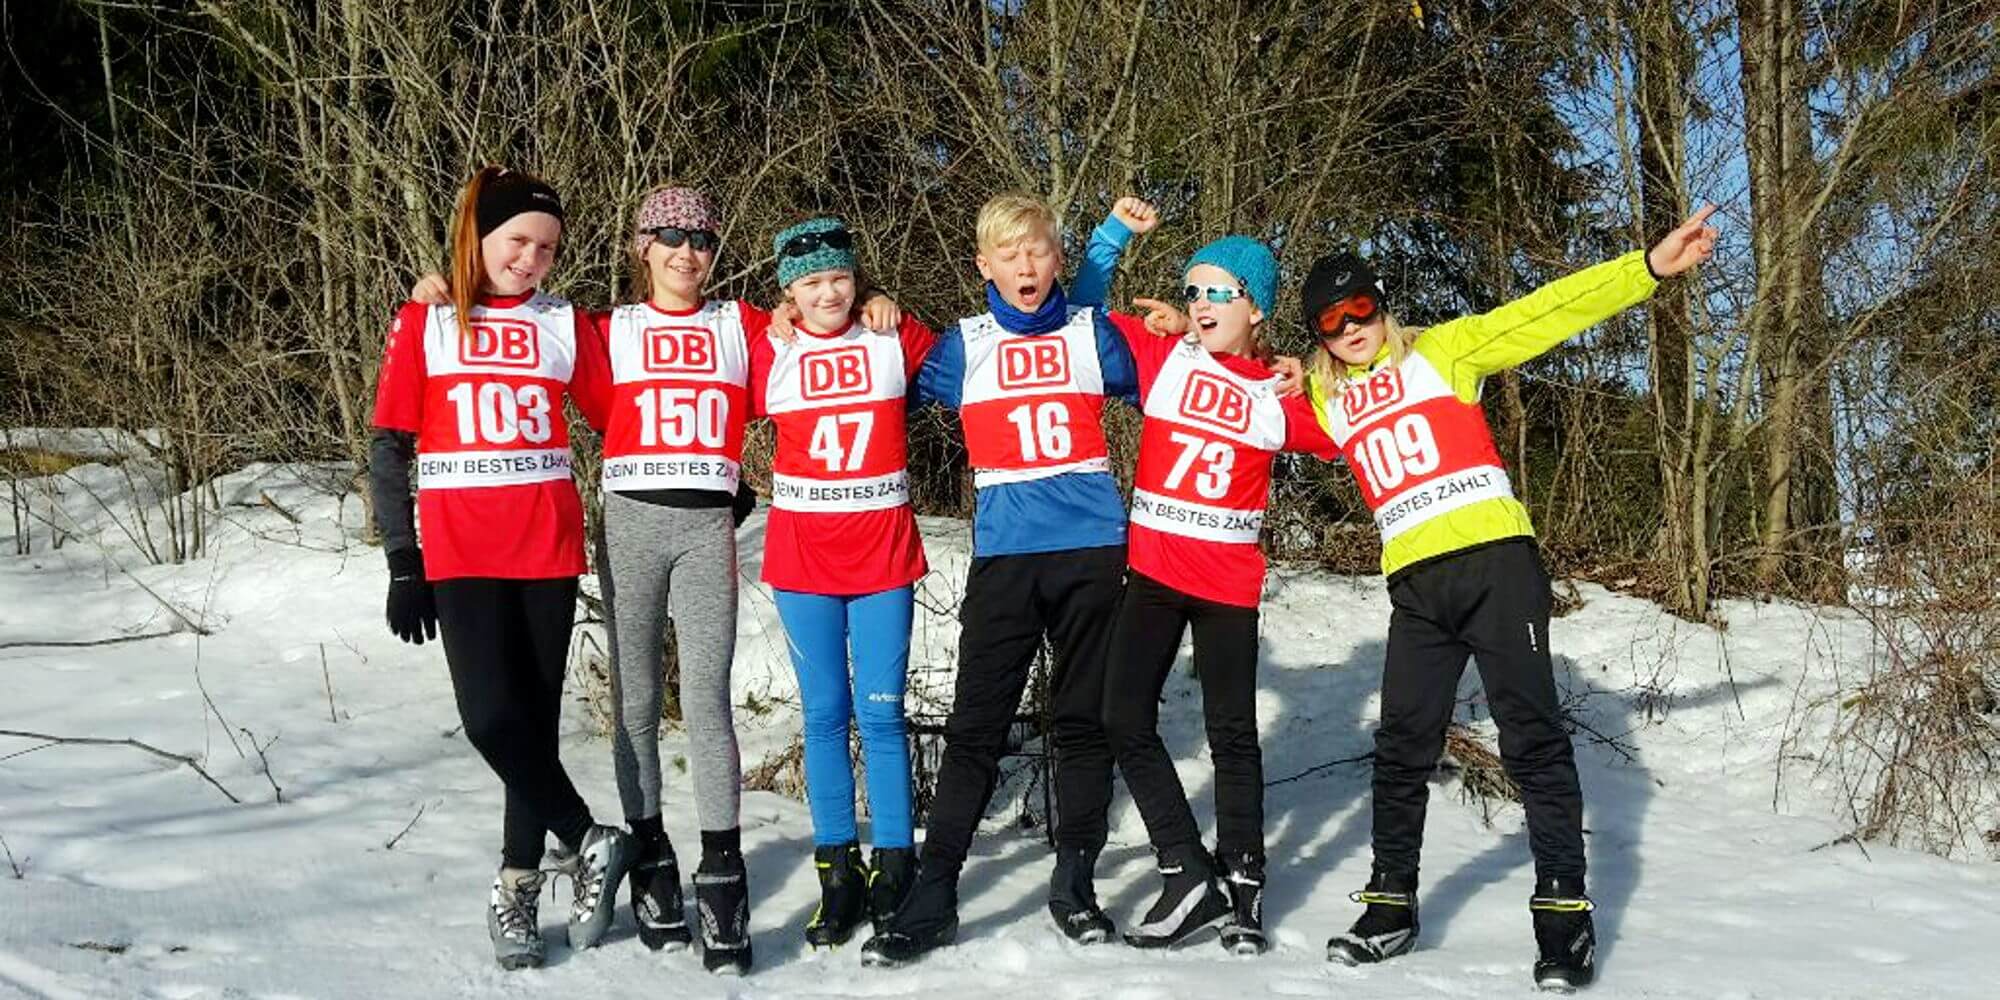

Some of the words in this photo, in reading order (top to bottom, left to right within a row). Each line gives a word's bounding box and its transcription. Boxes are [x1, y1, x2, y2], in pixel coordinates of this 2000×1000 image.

[469, 325, 530, 360] DB
[652, 333, 708, 366] DB
[1005, 344, 1061, 382] DB
[808, 355, 862, 393] DB
[1347, 371, 1394, 416] DB
[447, 382, 551, 444] 103
[634, 387, 729, 448] 150
[1189, 379, 1244, 423] DB
[808, 410, 874, 472] 47
[1007, 401, 1072, 462] 16
[421, 460, 458, 476] DEIN!
[464, 456, 537, 474] BESTES
[643, 462, 710, 476] BESTES
[1163, 431, 1235, 500] 73
[1354, 413, 1440, 498] 109
[810, 486, 874, 501] BESTES
[1383, 490, 1433, 527] BESTES
[1437, 472, 1493, 500] ZÄHLT
[1156, 503, 1220, 529] BESTES
